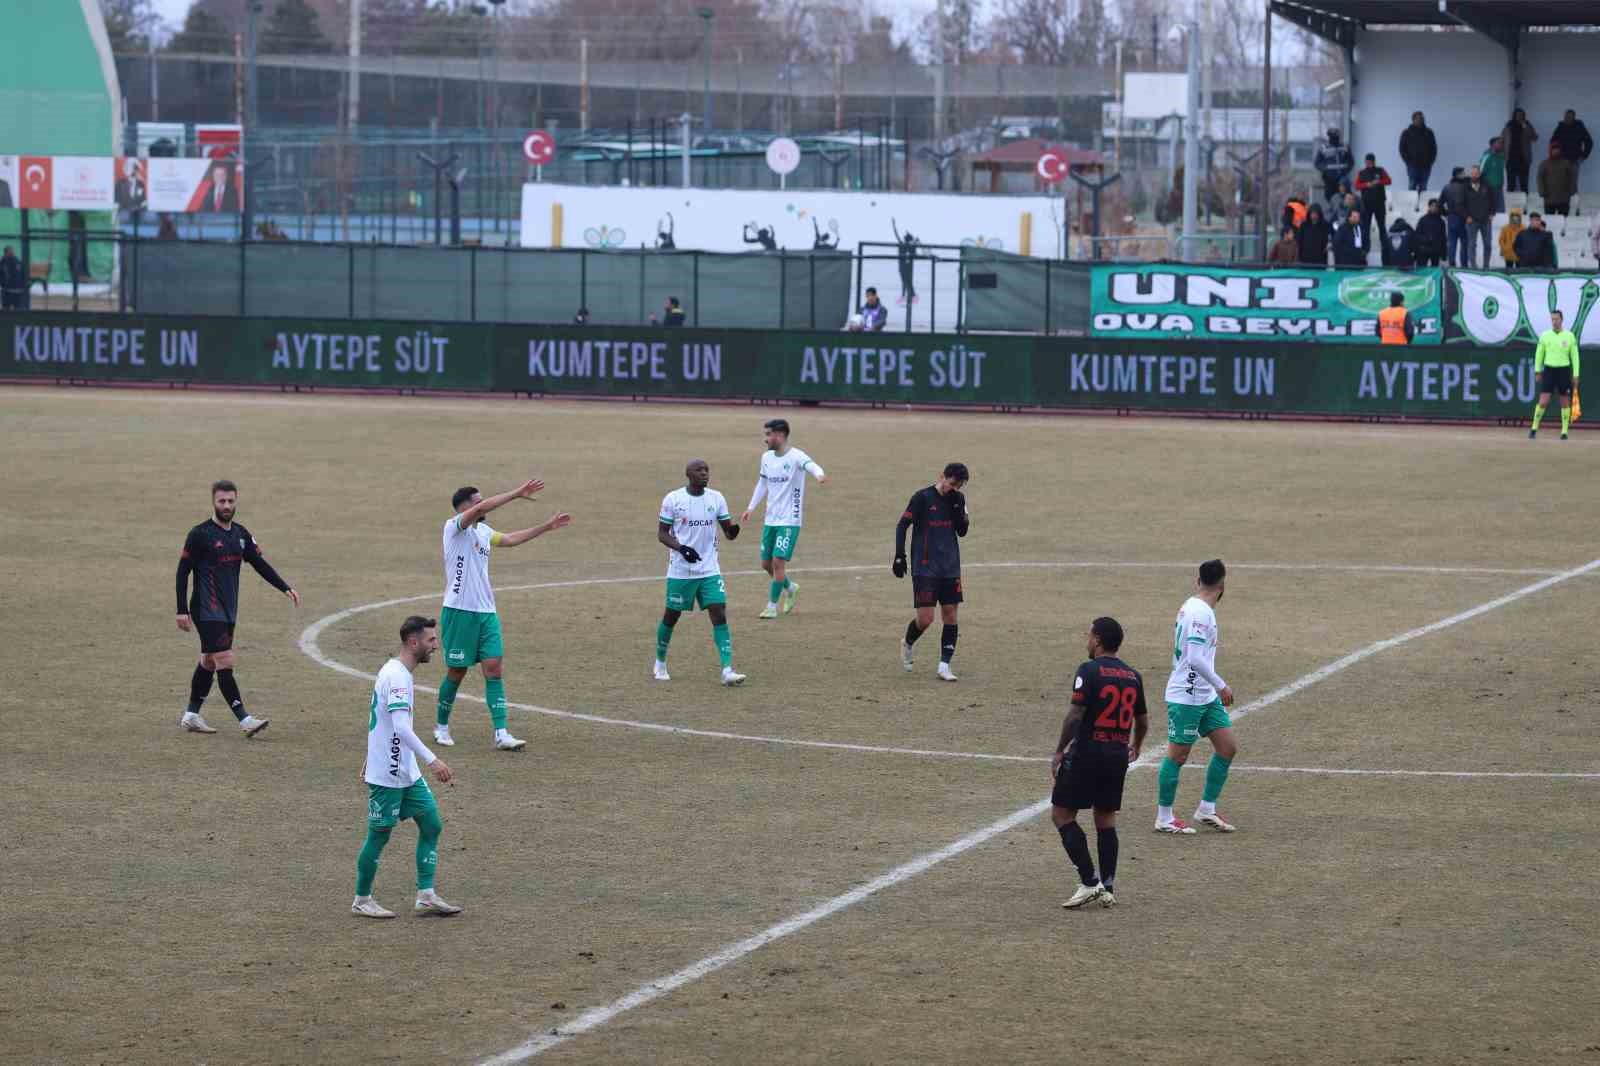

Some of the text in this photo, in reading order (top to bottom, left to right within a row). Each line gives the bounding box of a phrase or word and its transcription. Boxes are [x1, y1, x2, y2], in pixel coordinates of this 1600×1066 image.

[1112, 272, 1315, 309] UNI
[1093, 313, 1438, 336] OVA BEYLEI
[14, 325, 198, 367] KUMTEPE UN
[272, 331, 449, 373] AYTEPE SÜT
[528, 339, 722, 381] KUMTEPE UN
[800, 344, 987, 388] AYTEPE SÜT
[1069, 352, 1275, 396] KUMTEPE UN
[1358, 360, 1481, 401] AYTEPE
[1094, 684, 1137, 729] 28
